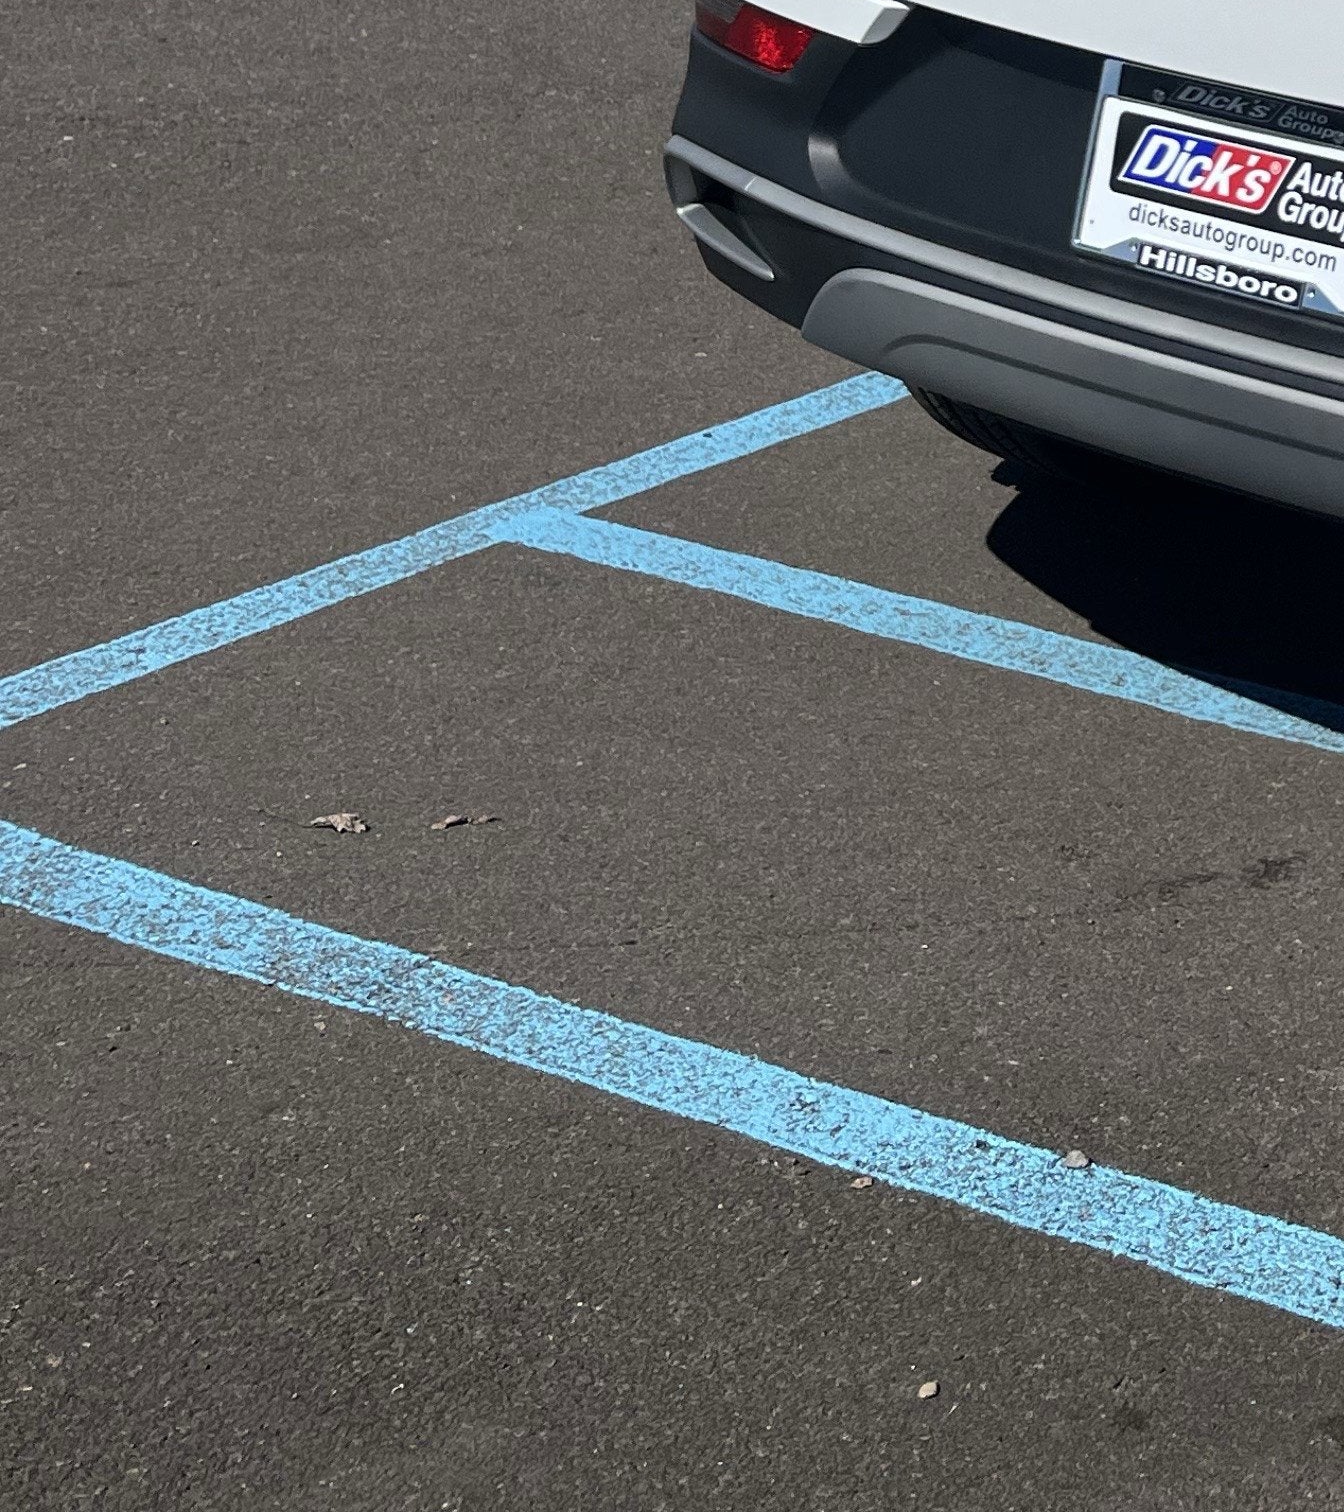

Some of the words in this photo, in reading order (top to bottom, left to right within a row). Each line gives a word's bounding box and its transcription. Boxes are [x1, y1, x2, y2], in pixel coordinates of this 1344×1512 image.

[1177, 85, 1271, 119] Dick's
[1284, 105, 1329, 125] Auto
[1131, 134, 1273, 204] Dick's
[1128, 202, 1338, 273] dicksautogroup.com
[1139, 244, 1299, 304] Hillsboro
